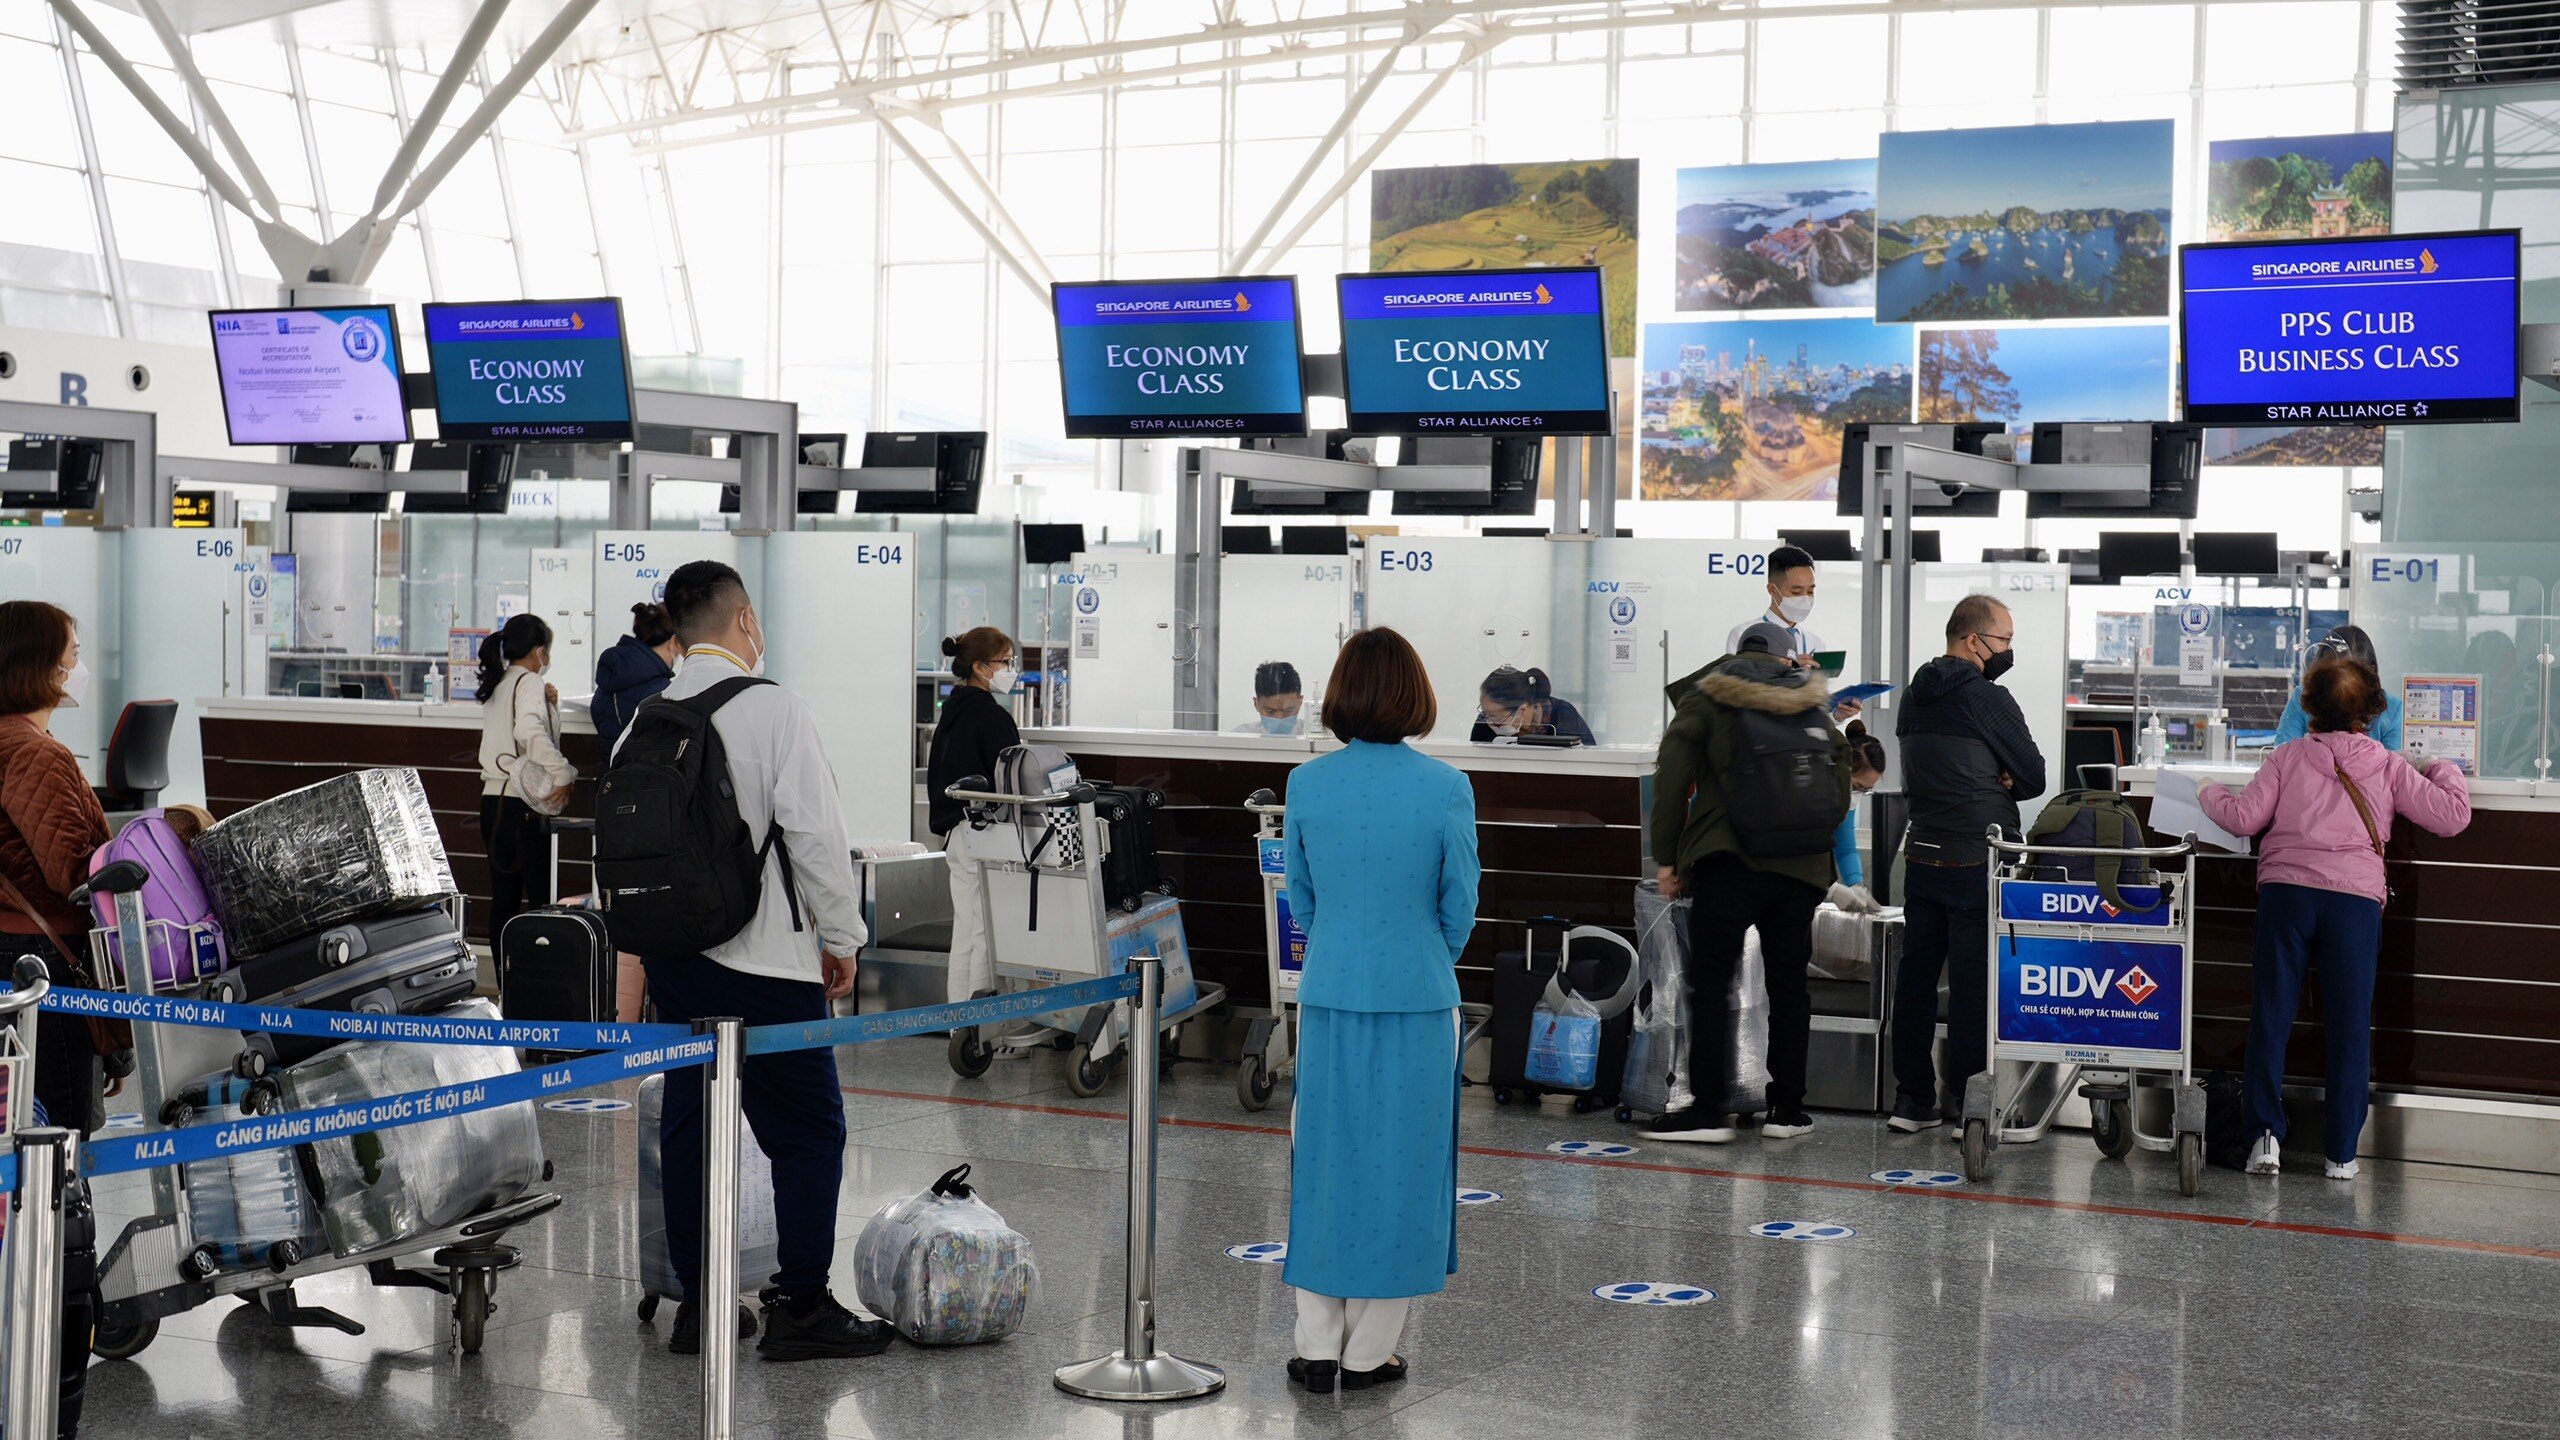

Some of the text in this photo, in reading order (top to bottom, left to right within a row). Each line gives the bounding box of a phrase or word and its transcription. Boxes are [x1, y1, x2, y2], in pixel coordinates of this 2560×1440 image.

[2252, 258, 2415, 275] SINGAPORE AIRLINES
[1096, 299, 1232, 312] SINGAPORE AIRLINES
[1384, 291, 1532, 304] SINGAPORE AIRLINES
[217, 320, 242, 331] NIA
[459, 318, 569, 330] SINGAPORE AIRLINES
[2281, 310, 2415, 337] PPS CLUB
[1106, 345, 1249, 368] ECONOMY
[1394, 339, 1550, 363] ECONOMY
[2239, 344, 2460, 373] BUSINESS CLASS
[265, 366, 313, 375] International
[314, 366, 341, 375] Airport
[469, 359, 585, 380] ECONOMY
[1137, 371, 1224, 395] CLASS
[1427, 366, 1522, 391] CLASS
[495, 382, 566, 405] CLASS
[2267, 404, 2407, 419] STAR ALLIANCE
[1130, 419, 1234, 429] STAR ALLIANCE
[1418, 416, 1531, 427] STAR ALLIANCE
[491, 426, 575, 436] STAR ALLIANCE
[511, 491, 553, 506] HECK
[197, 540, 233, 557] E-06
[604, 543, 645, 562] E-05
[857, 545, 902, 565] E-04
[234, 563, 255, 573] ACV
[1380, 550, 1433, 572] E-03
[1708, 553, 1765, 575] E-02
[636, 569, 660, 579] ACV
[2372, 558, 2438, 582] E-01
[1057, 574, 1086, 584] ACV
[1587, 582, 1620, 593] ACV
[2155, 588, 2192, 600] ACV
[2156, 606, 2179, 615] G-0
[2042, 893, 2100, 914] BIDV
[2020, 964, 2115, 999] BIDV
[62, 994, 108, 1012] KHÔNG
[112, 997, 151, 1016] QUỐC
[155, 1000, 172, 1018] TẾ
[174, 1004, 198, 1023] NỘI
[260, 1013, 293, 1028] N.I.A
[330, 1018, 378, 1034] NOIBAI
[381, 1023, 494, 1040] INTERNATIONAL
[499, 1027, 561, 1043] AIRPORT
[596, 1029, 632, 1044] N.I.A
[2020, 1004, 2038, 1014] CHIA
[2049, 1005, 2060, 1015] CƠ
[2078, 1007, 2095, 1018] HỢP
[2095, 1007, 2110, 1018] TÁC
[2110, 1008, 2137, 1019] THÀNH
[2138, 1009, 2160, 1020] CÔNG
[2065, 1050, 2096, 1058] BIZMAN
[134, 1138, 176, 1160] N.I.A
[216, 1125, 263, 1149] CẢNG
[266, 1114, 311, 1141] HÀNG
[314, 1109, 368, 1133] KHÔNG
[371, 1096, 412, 1123] QUỐC
[414, 1091, 434, 1115] TẾ
[435, 1089, 460, 1113] NỘI
[541, 1069, 572, 1088] N.I.A
[624, 1048, 664, 1069] NOIBAI
